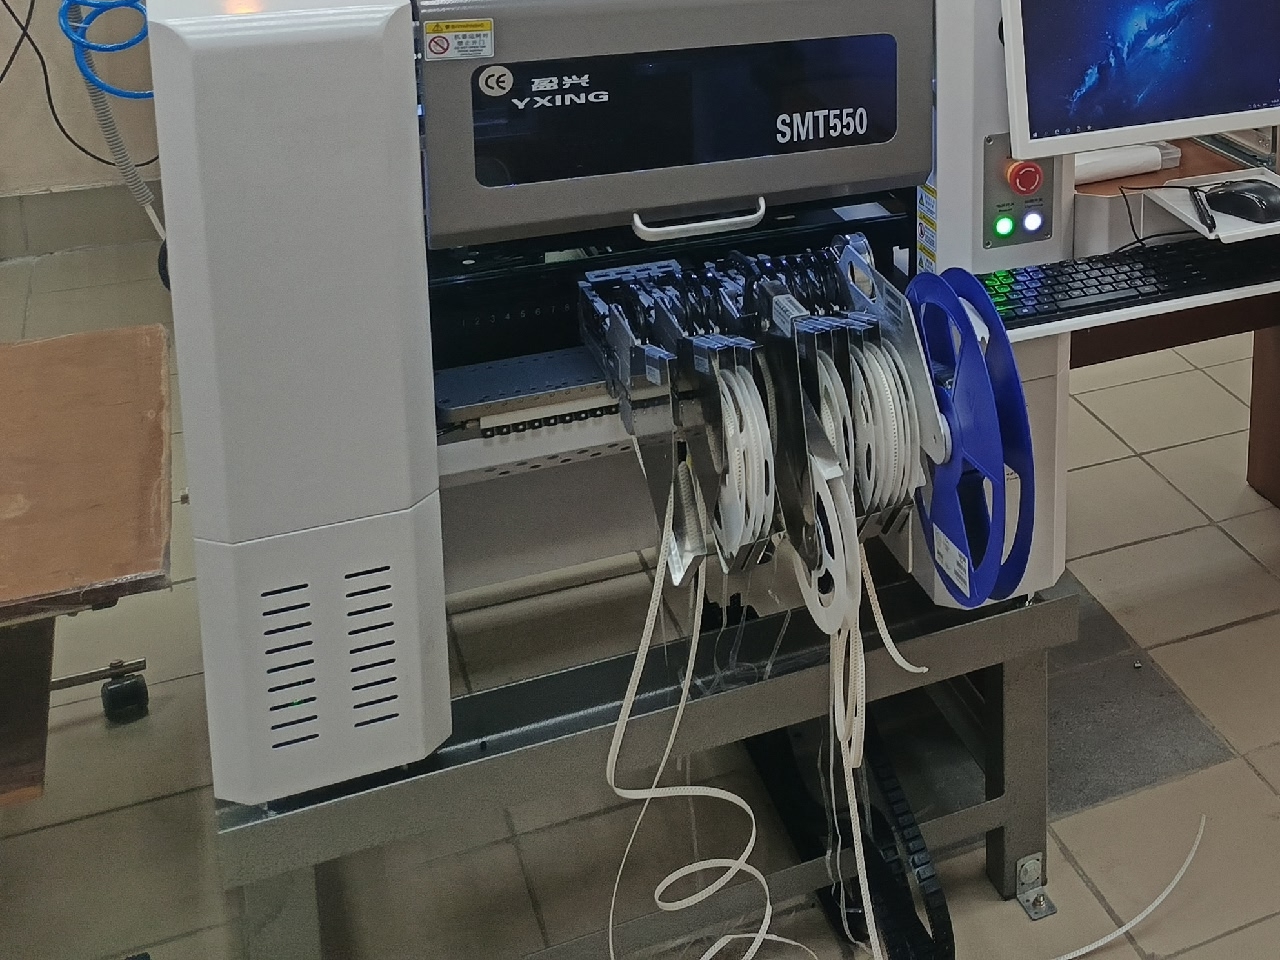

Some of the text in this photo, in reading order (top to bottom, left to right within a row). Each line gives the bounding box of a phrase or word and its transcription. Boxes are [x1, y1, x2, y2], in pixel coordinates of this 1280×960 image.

[484, 73, 507, 90] CE
[511, 91, 609, 109] YXING
[776, 107, 868, 144] SMT550
[489, 314, 496, 323] 3
[520, 310, 526, 318] 5
[535, 307, 541, 316] 6
